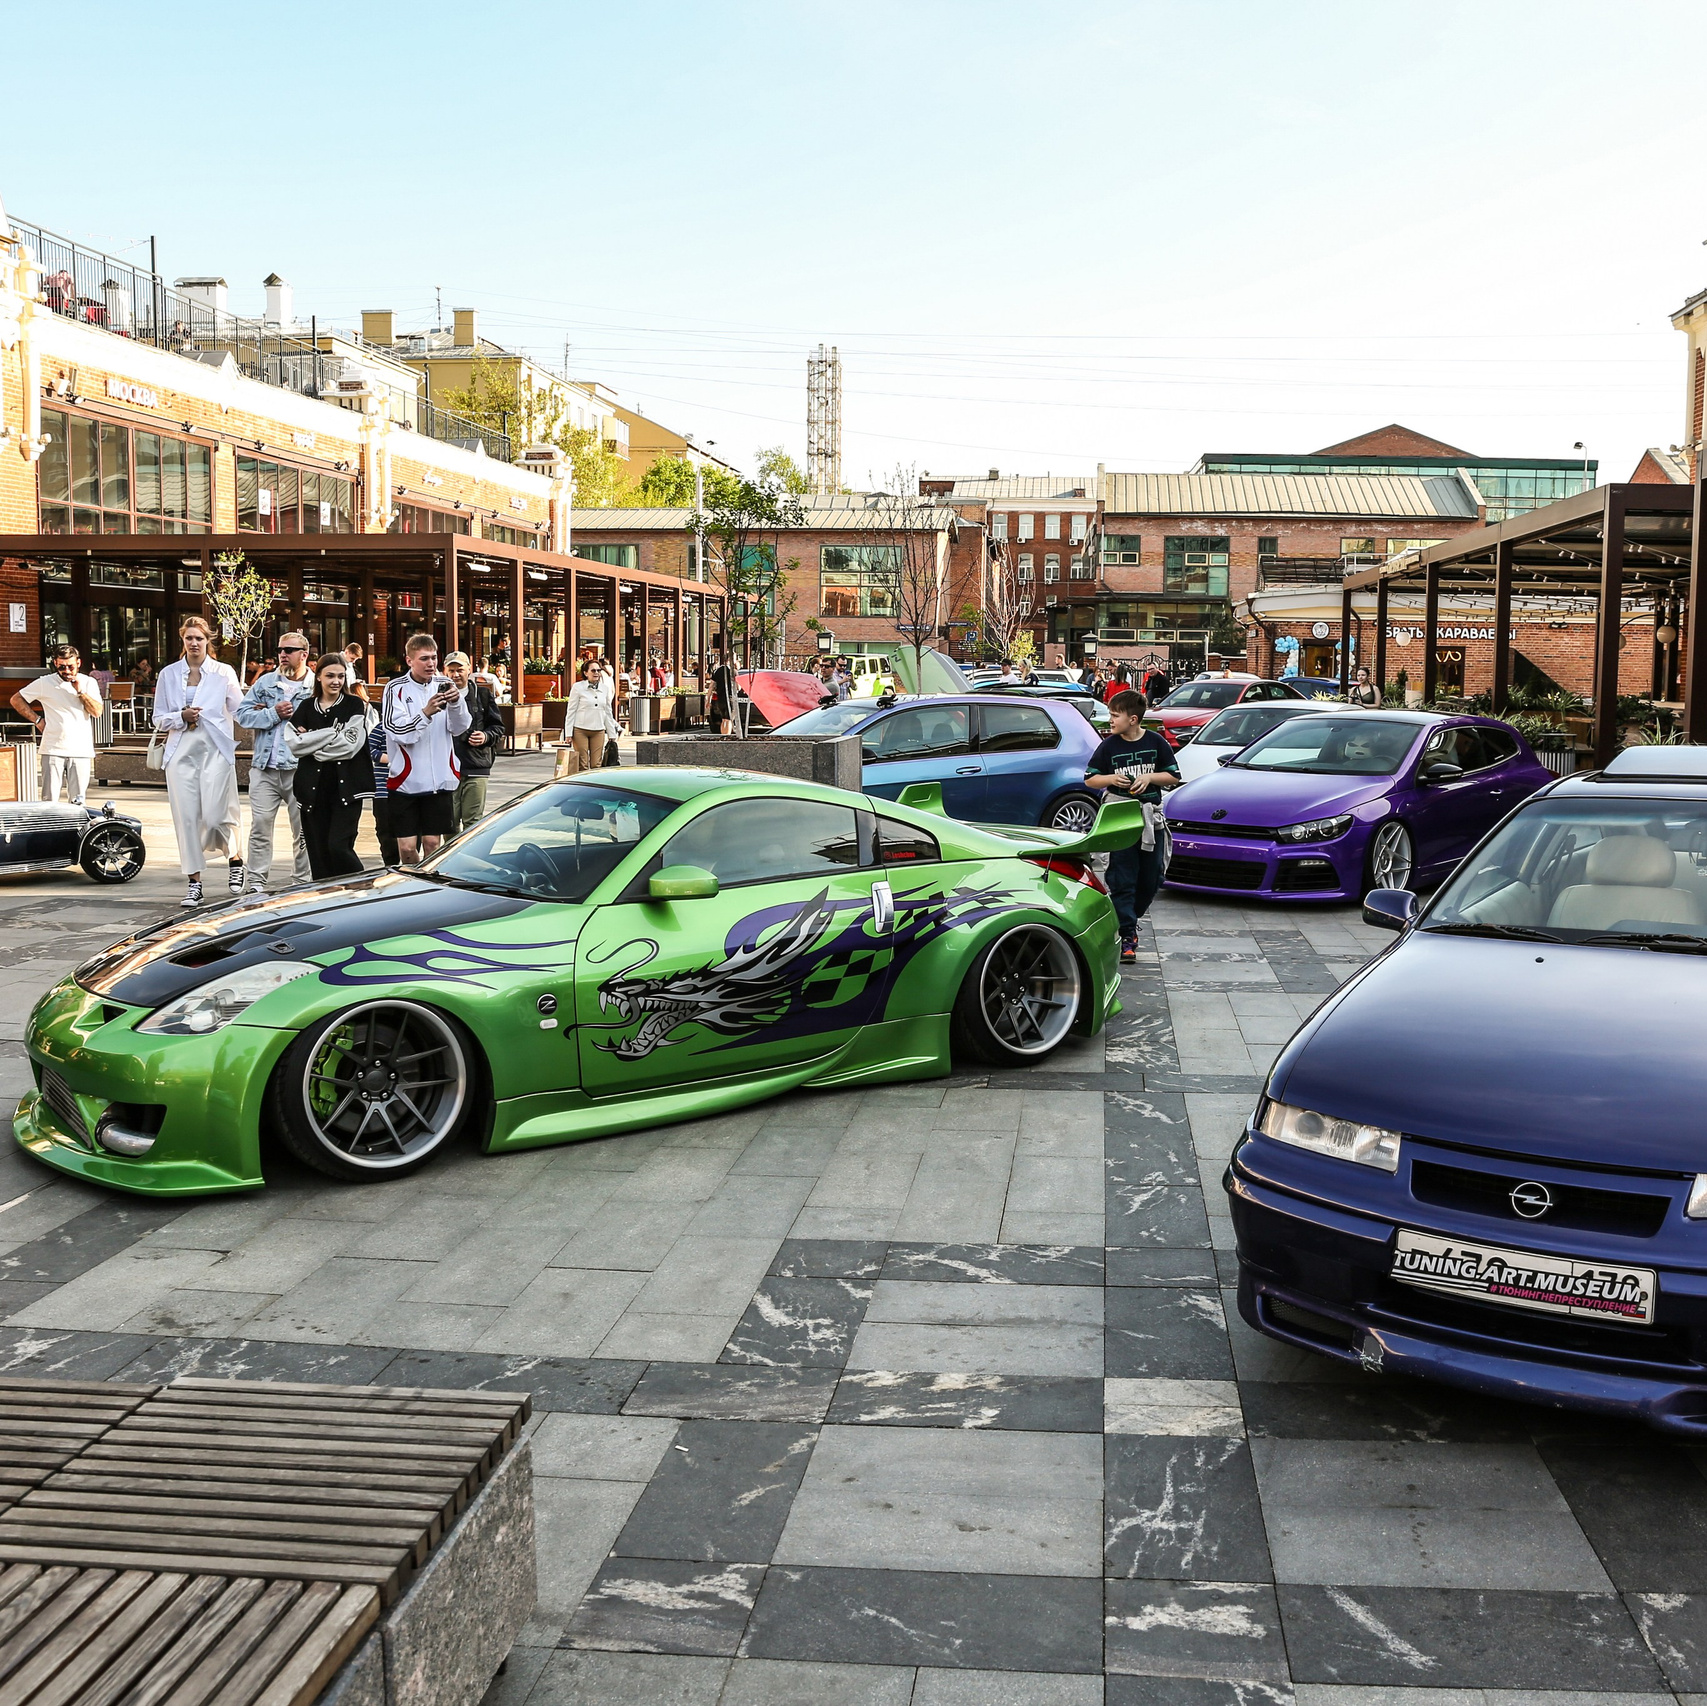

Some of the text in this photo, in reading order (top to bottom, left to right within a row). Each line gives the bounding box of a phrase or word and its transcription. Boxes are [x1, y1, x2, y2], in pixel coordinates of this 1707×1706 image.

[108, 378, 159, 408] МОСКВА
[19, 605, 25, 621] 2
[1436, 627, 1516, 640] КАРАВАЕЫ
[1394, 1250, 1641, 1303] TUNING.ART.MUSEUM
[1489, 1284, 1639, 1314] #ТЮНИНГНЕПРЕСТУПЛЕНИЕ
